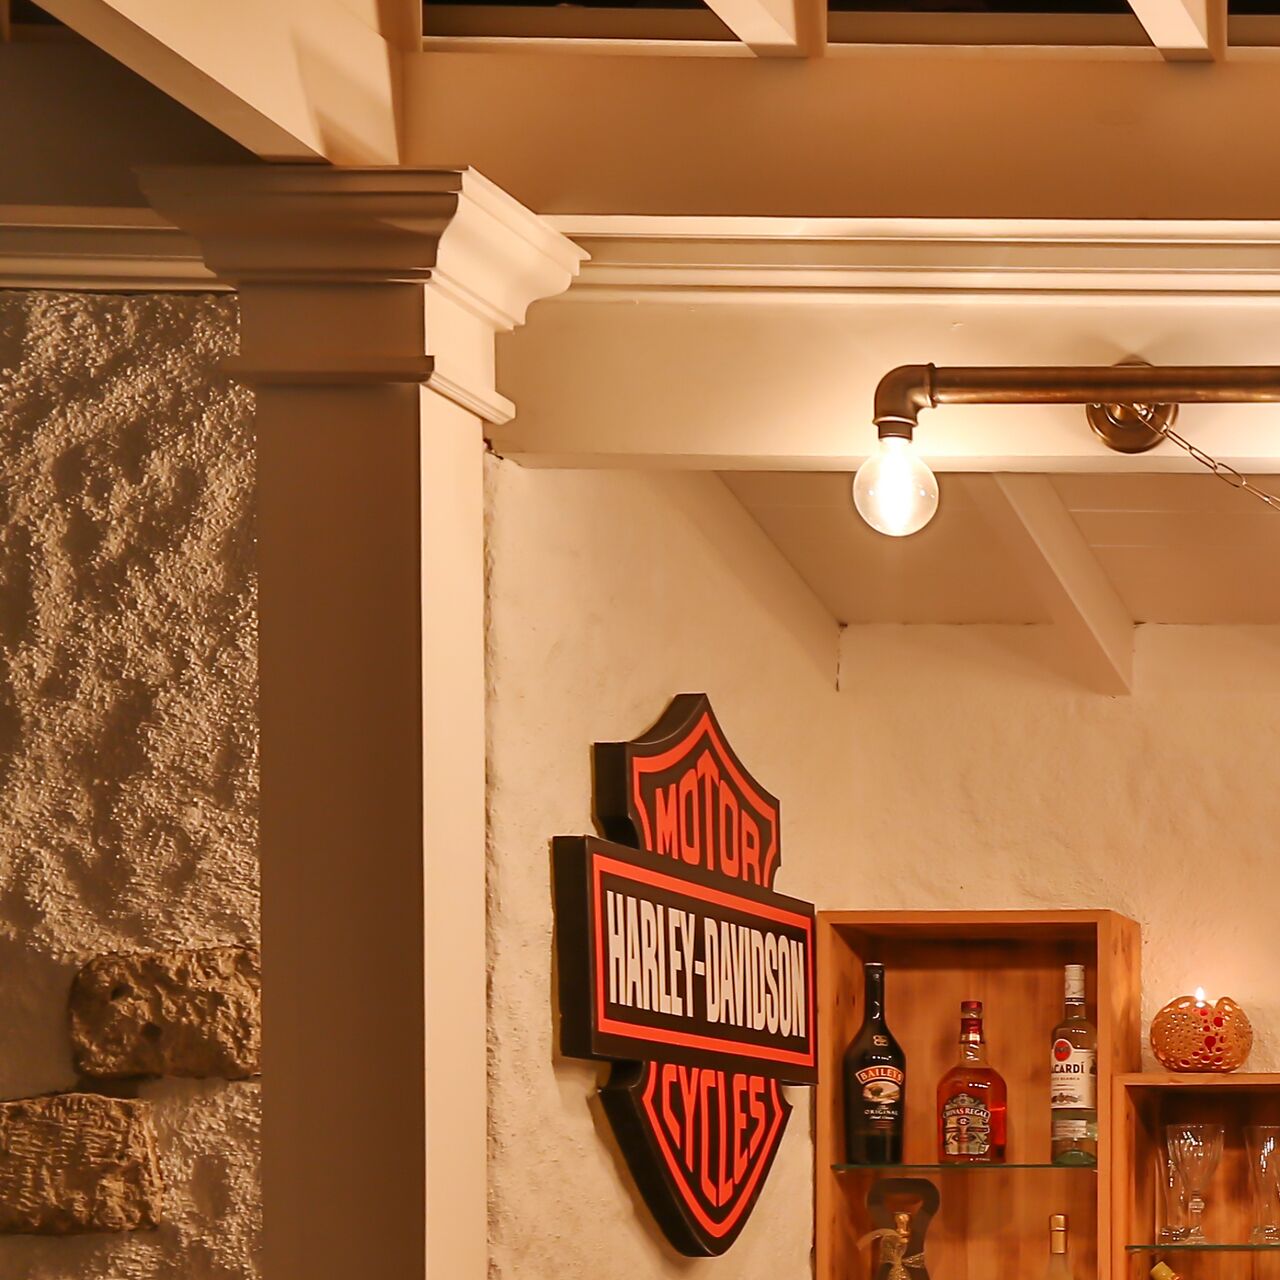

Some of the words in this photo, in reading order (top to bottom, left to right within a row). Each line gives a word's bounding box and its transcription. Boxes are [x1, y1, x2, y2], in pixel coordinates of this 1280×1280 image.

[655, 748, 762, 882] MOTOR
[606, 891, 806, 1038] HARLEY-DAVIDSON
[860, 1068, 902, 1081] BAILEYS
[1051, 1061, 1084, 1074] CARDÍ
[663, 1062, 766, 1208] CYCLES
[965, 1107, 987, 1118] REGAL
